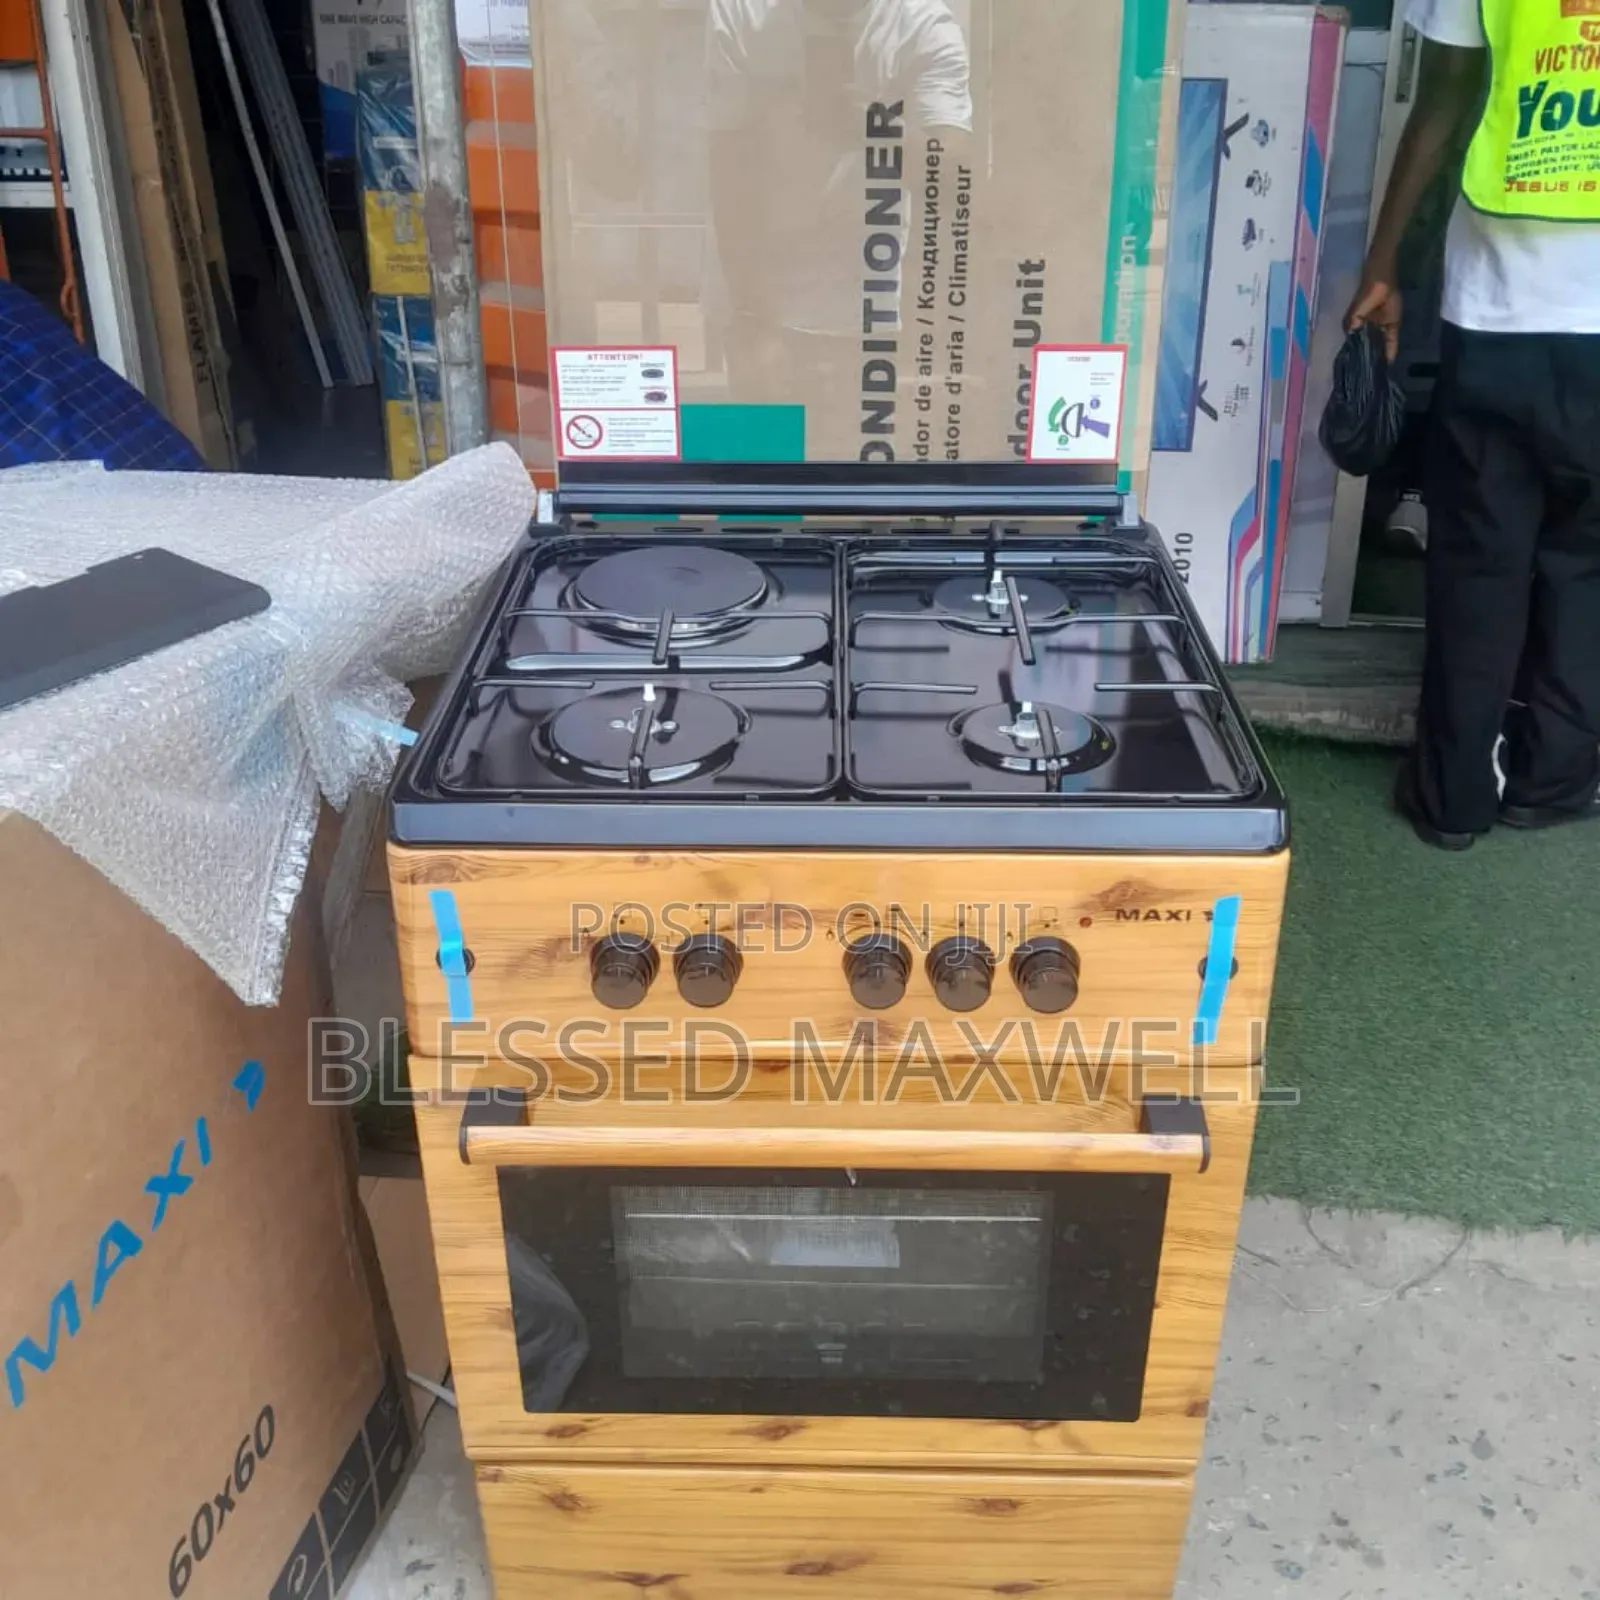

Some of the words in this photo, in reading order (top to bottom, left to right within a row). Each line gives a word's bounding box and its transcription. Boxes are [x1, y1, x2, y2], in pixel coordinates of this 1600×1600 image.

[1504, 180, 1569, 193] JESUS
[1577, 180, 1598, 193] IS
[917, 138, 945, 310] Кондиционер
[948, 165, 972, 307] Climatiseur
[1011, 258, 1046, 348] Unit
[915, 333, 934, 377] aire
[945, 330, 965, 395] d'aria
[913, 386, 931, 412] de
[912, 420, 930, 462] dor
[1115, 907, 1192, 922] MAXI
[4, 1115, 213, 1408] MAXI
[168, 1404, 276, 1600] 60x60
